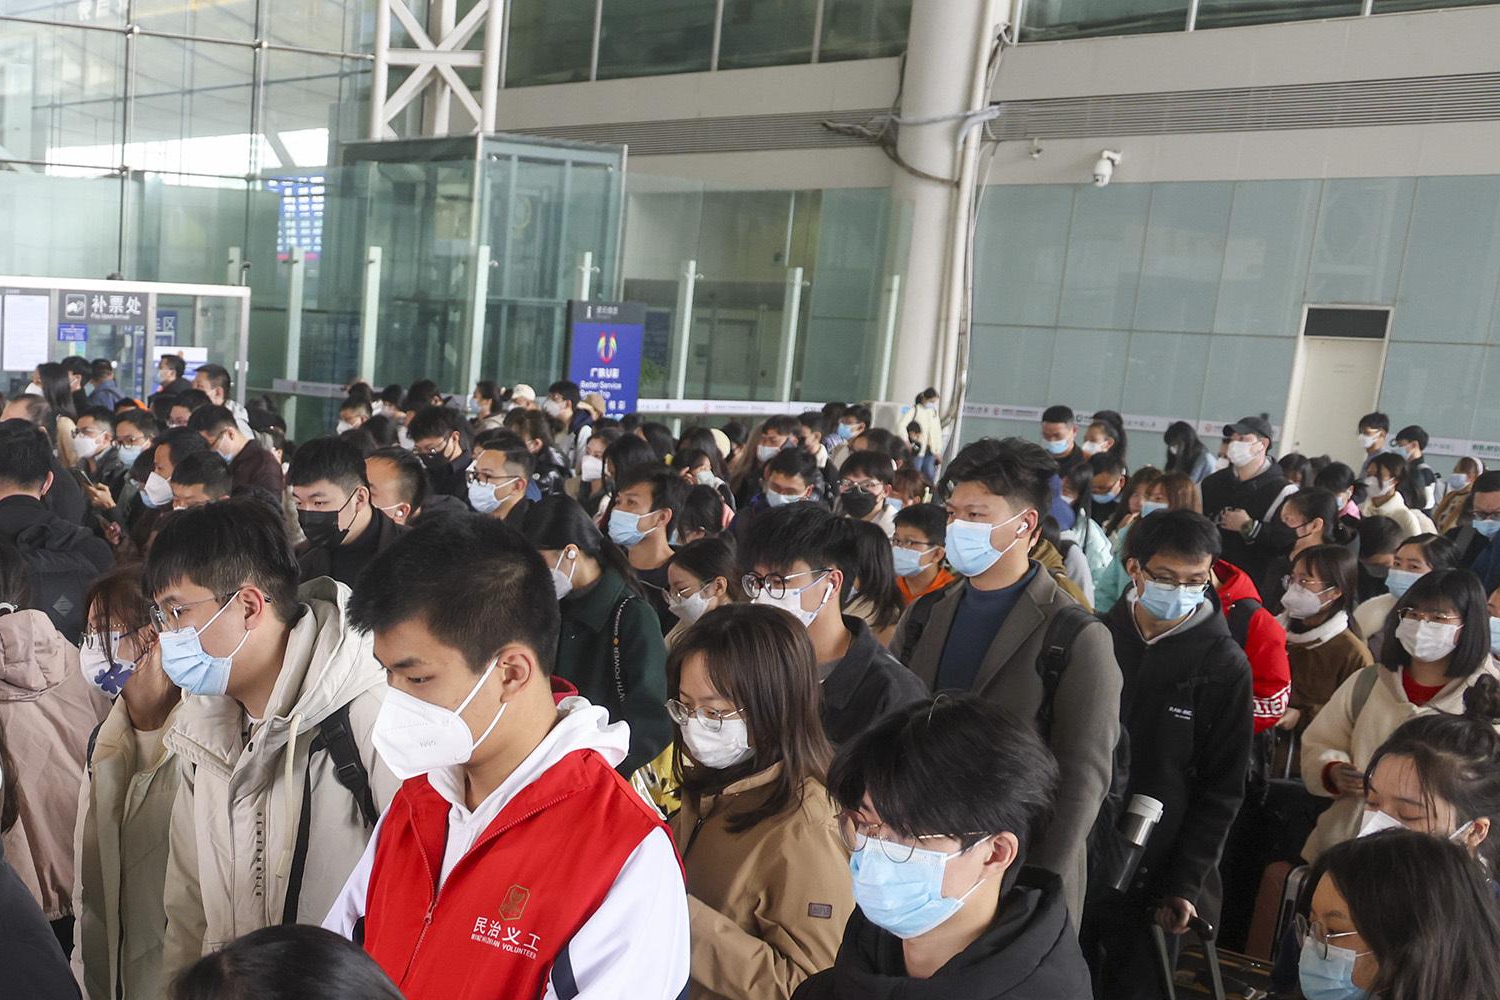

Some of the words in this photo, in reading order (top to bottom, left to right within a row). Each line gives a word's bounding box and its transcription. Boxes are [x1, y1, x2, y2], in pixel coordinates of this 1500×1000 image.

[91, 295, 142, 315] 补票处
[472, 916, 541, 951] 民治义工
